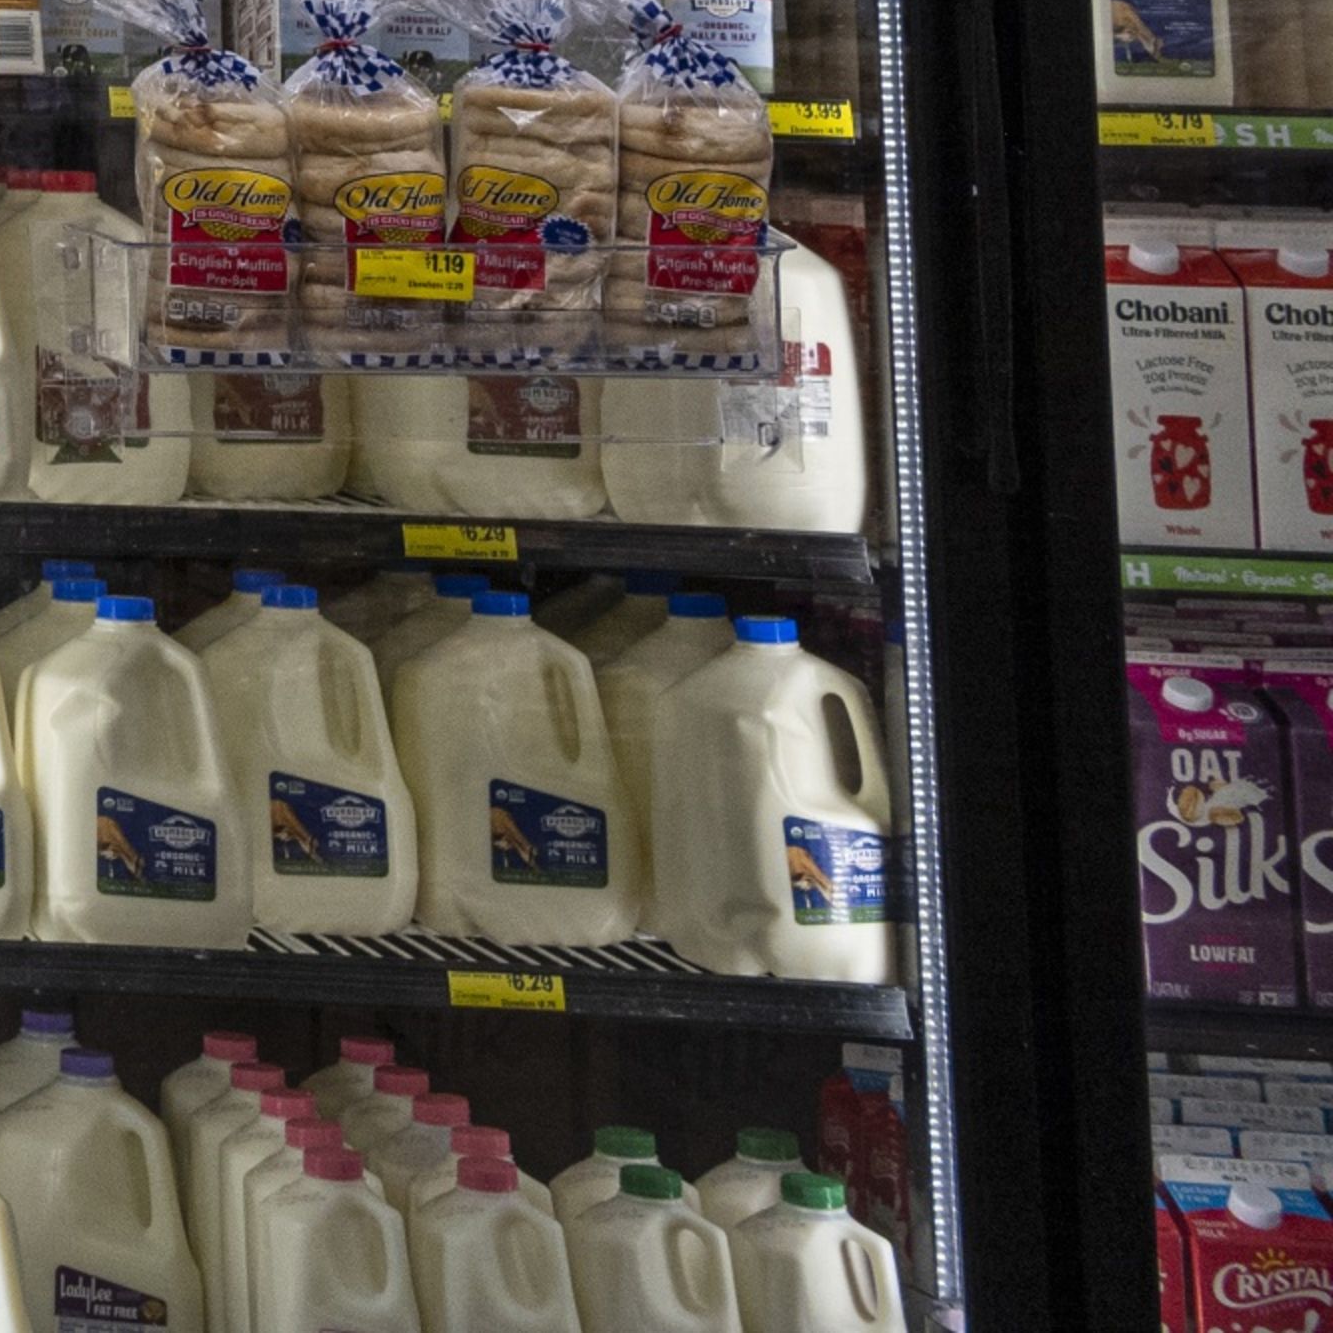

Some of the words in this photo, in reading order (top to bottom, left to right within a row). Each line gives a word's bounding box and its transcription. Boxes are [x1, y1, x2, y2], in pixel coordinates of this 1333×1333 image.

[174, 179, 221, 203] Old
[225, 186, 285, 206] Home
[345, 187, 390, 209] Old
[483, 183, 550, 208] Home
[656, 180, 699, 204] Old
[703, 186, 762, 211] Home
[178, 253, 232, 267] English
[425, 254, 465, 274] $1.19
[1115, 299, 1229, 324] Chobani
[1122, 326, 1197, 340] Ultra-Filtered
[1200, 328, 1226, 341] Milk
[1136, 356, 1186, 371] Lactose
[1188, 356, 1214, 374] Free
[1143, 372, 1165, 385] 20g
[1168, 370, 1208, 386] Protein
[1165, 525, 1201, 536] Whole
[1174, 566, 1228, 584] Natural
[1242, 570, 1297, 589] Organic
[1171, 748, 1242, 783] OAT
[160, 852, 201, 862] ORGANIC
[1137, 812, 1290, 924] Silk
[1190, 945, 1255, 964] LOWFAT
[60, 1274, 113, 1314] LadyLee
[94, 1305, 111, 1316] FAT
[113, 1306, 138, 1319] FREE
